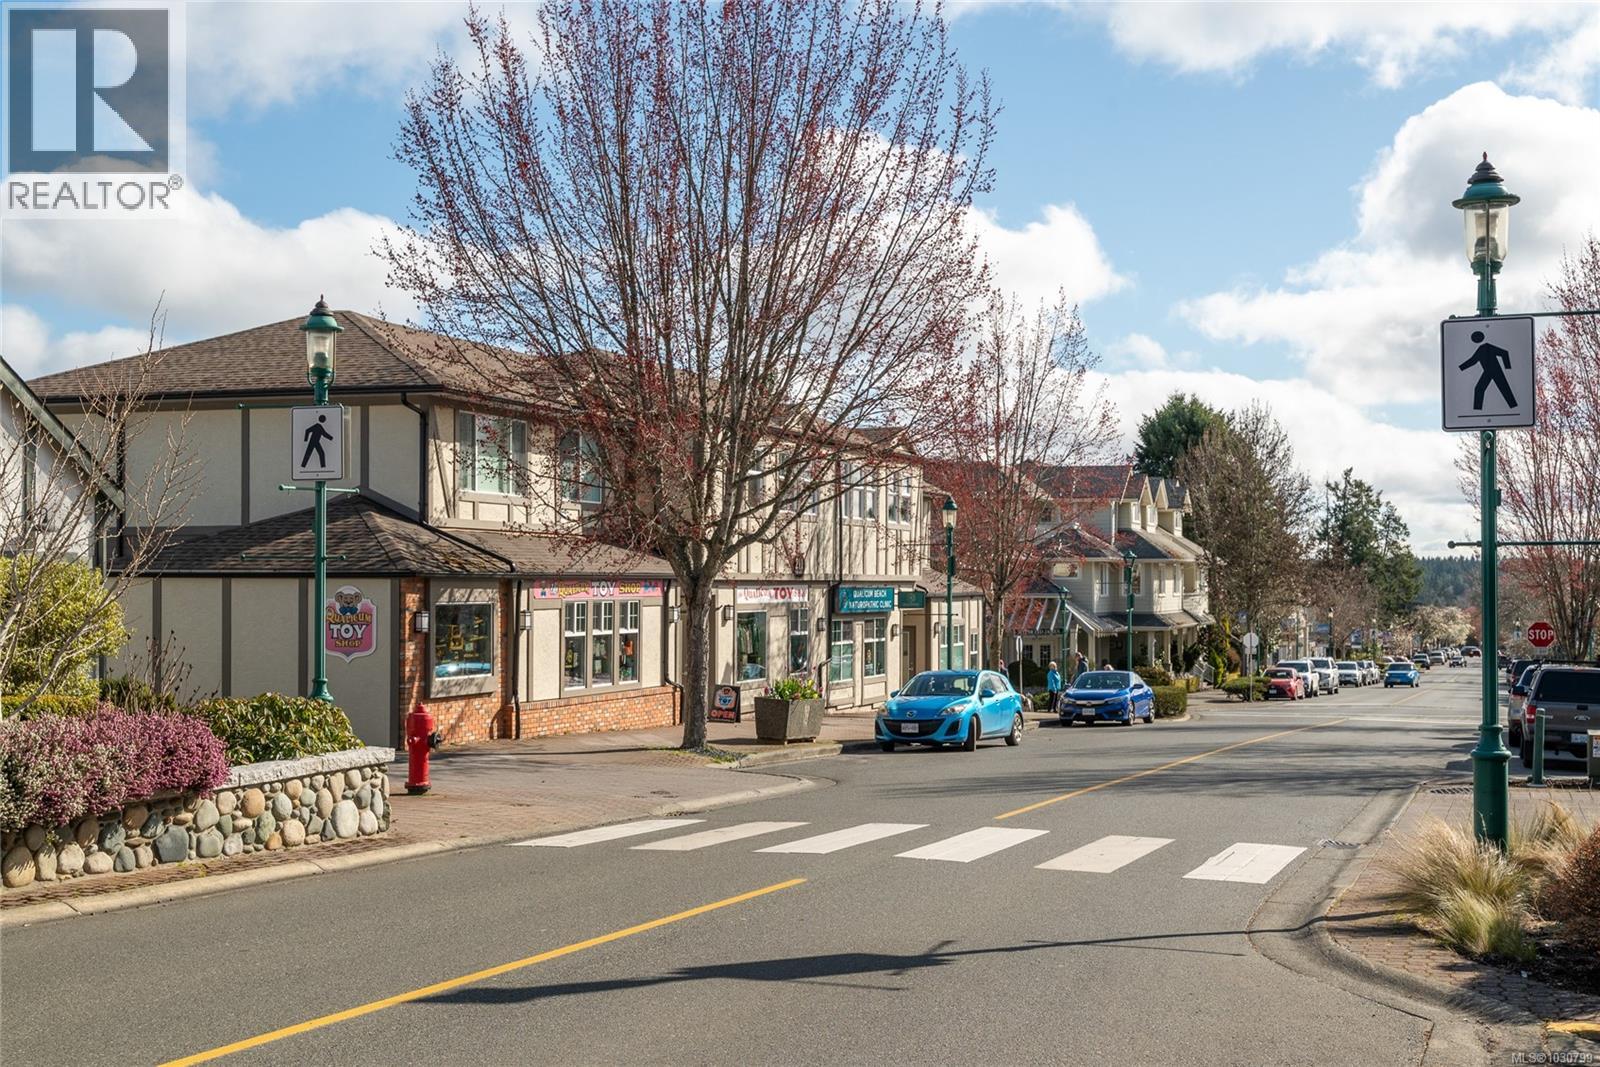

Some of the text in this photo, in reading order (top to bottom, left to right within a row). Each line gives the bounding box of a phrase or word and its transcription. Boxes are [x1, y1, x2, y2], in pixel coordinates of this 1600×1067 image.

[592, 580, 615, 597] TOY
[619, 582, 640, 595] SHOP
[773, 586, 793, 600] TOY
[329, 623, 367, 640] TOY
[1528, 629, 1554, 640] STOP
[335, 640, 361, 648] SHOP
[710, 709, 736, 719] OPEN
